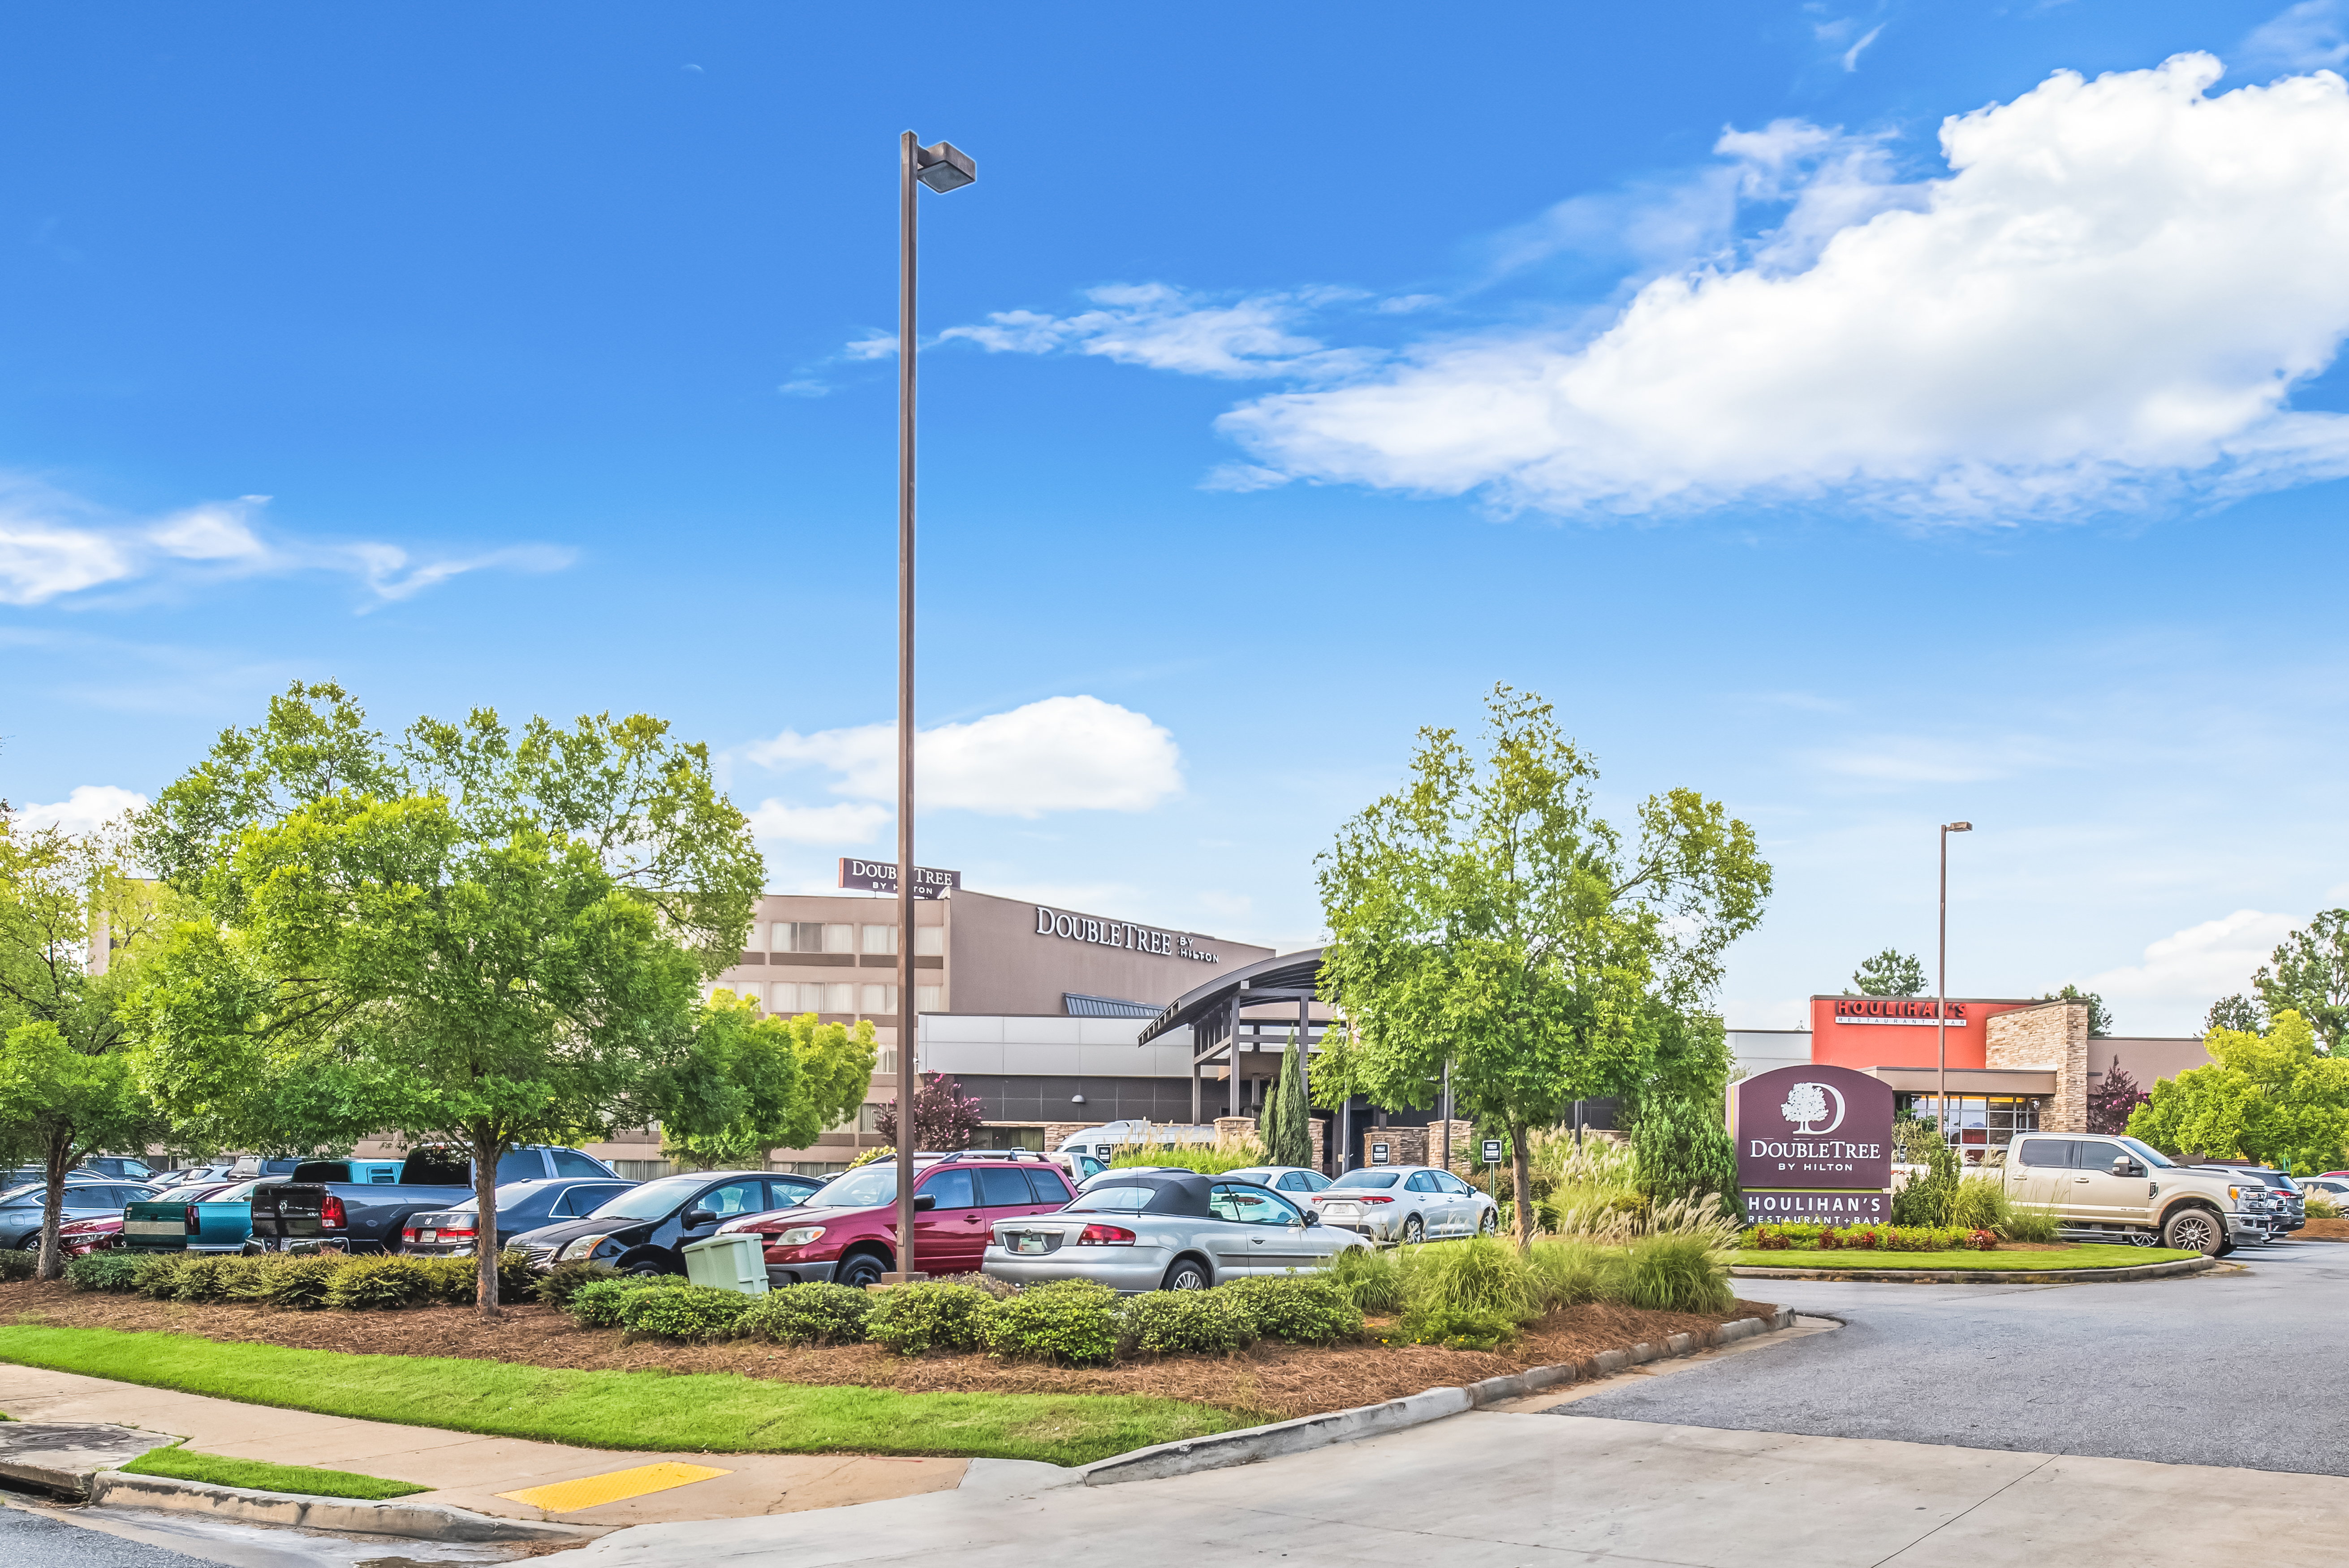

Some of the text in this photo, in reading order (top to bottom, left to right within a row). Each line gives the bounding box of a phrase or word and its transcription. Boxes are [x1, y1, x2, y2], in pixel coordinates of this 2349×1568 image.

[852, 861, 953, 886] DOUBTREE
[873, 881, 932, 894] BY HTON
[1036, 906, 1172, 956] DOUBLETREE
[1179, 936, 1194, 947] BY
[1181, 948, 1219, 963] HILTON
[1750, 1140, 1880, 1159] DOUBLETREE
[1748, 1197, 1880, 1211] HOULIHAN'S
